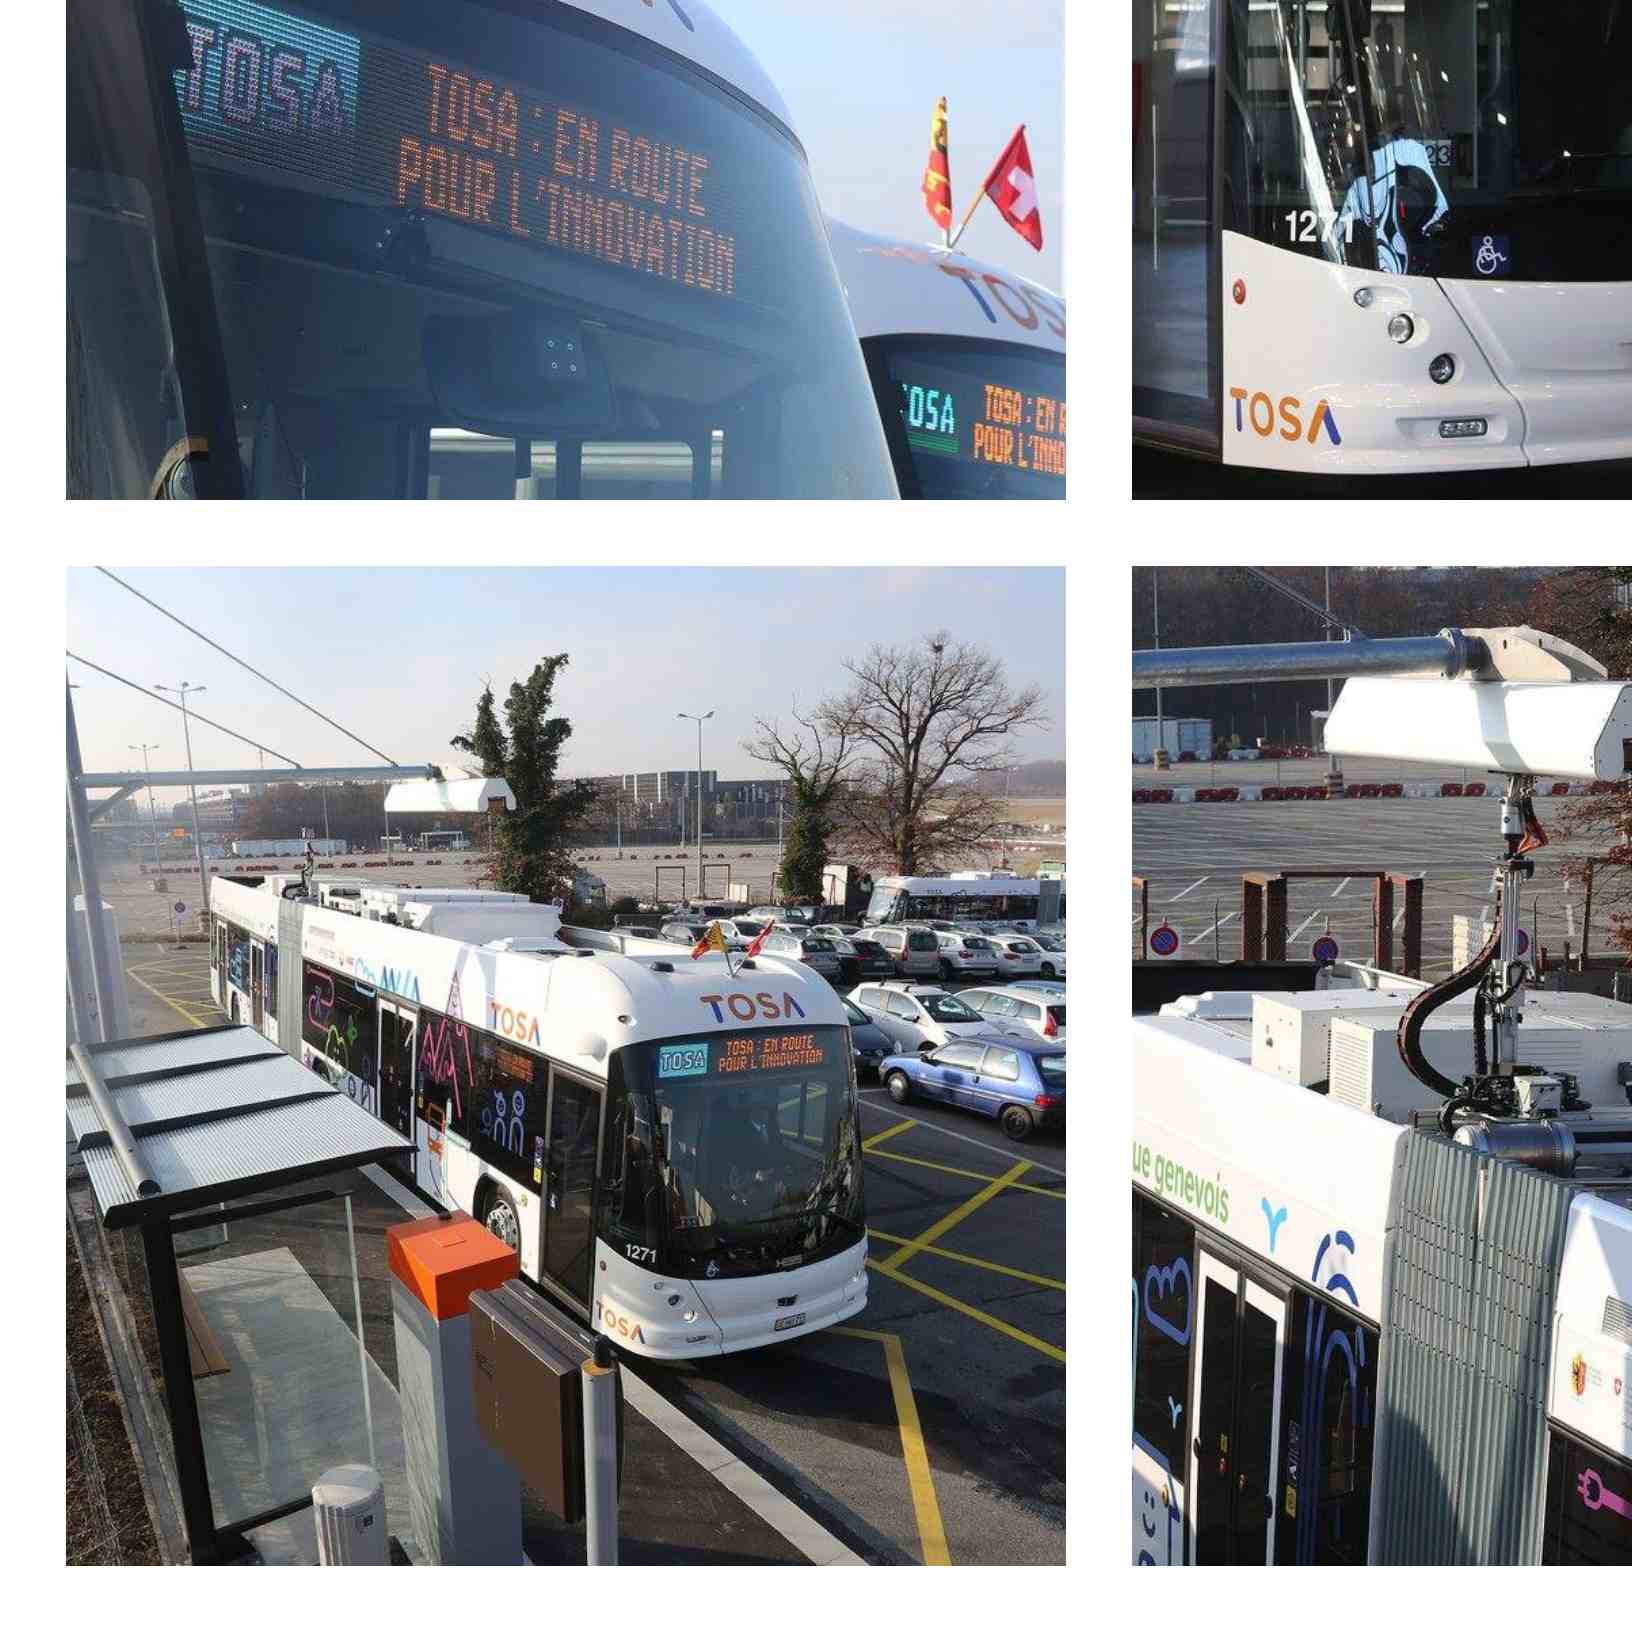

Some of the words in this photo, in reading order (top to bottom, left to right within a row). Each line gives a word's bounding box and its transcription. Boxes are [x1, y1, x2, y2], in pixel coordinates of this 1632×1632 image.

[183, 23, 345, 135] TOSA
[427, 64, 519, 158] TOSA
[555, 109, 599, 182] EN
[610, 128, 711, 217] ROUTE
[1425, 144, 1450, 164] 23
[399, 135, 496, 224] POUR
[512, 169, 736, 295] L'INNOVATION
[901, 384, 955, 434] OSA
[985, 384, 1022, 425] TOSA
[1230, 387, 1341, 445] TOSA
[974, 424, 1012, 464] POUR
[490, 1001, 541, 1047] TOSA
[700, 992, 806, 1024] TOSA
[661, 1051, 705, 1072] TOSA
[719, 1055, 747, 1072] POUR
[726, 1039, 753, 1059] TOSA
[764, 1037, 779, 1053] EN
[781, 1034, 815, 1051] ROUTE
[1154, 1152, 1230, 1225] genevois
[625, 1243, 657, 1263] 1271
[596, 1296, 646, 1344] TOSA
